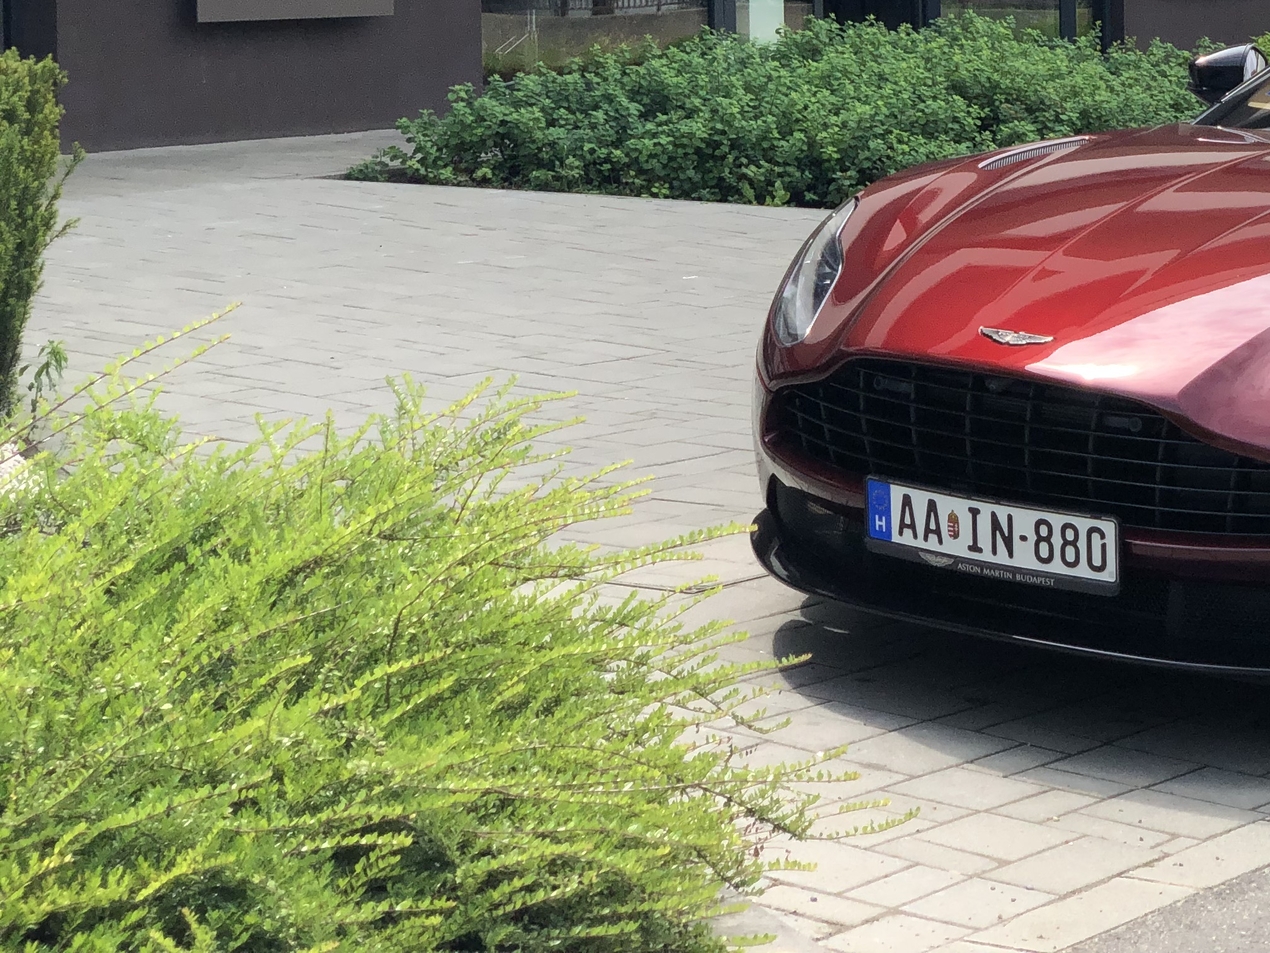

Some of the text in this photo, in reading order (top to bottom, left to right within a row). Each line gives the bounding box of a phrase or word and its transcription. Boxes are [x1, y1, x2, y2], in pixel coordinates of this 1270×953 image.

[875, 514, 886, 533] H
[957, 562, 1055, 587] ASTON MARTIN BUDAPEST
